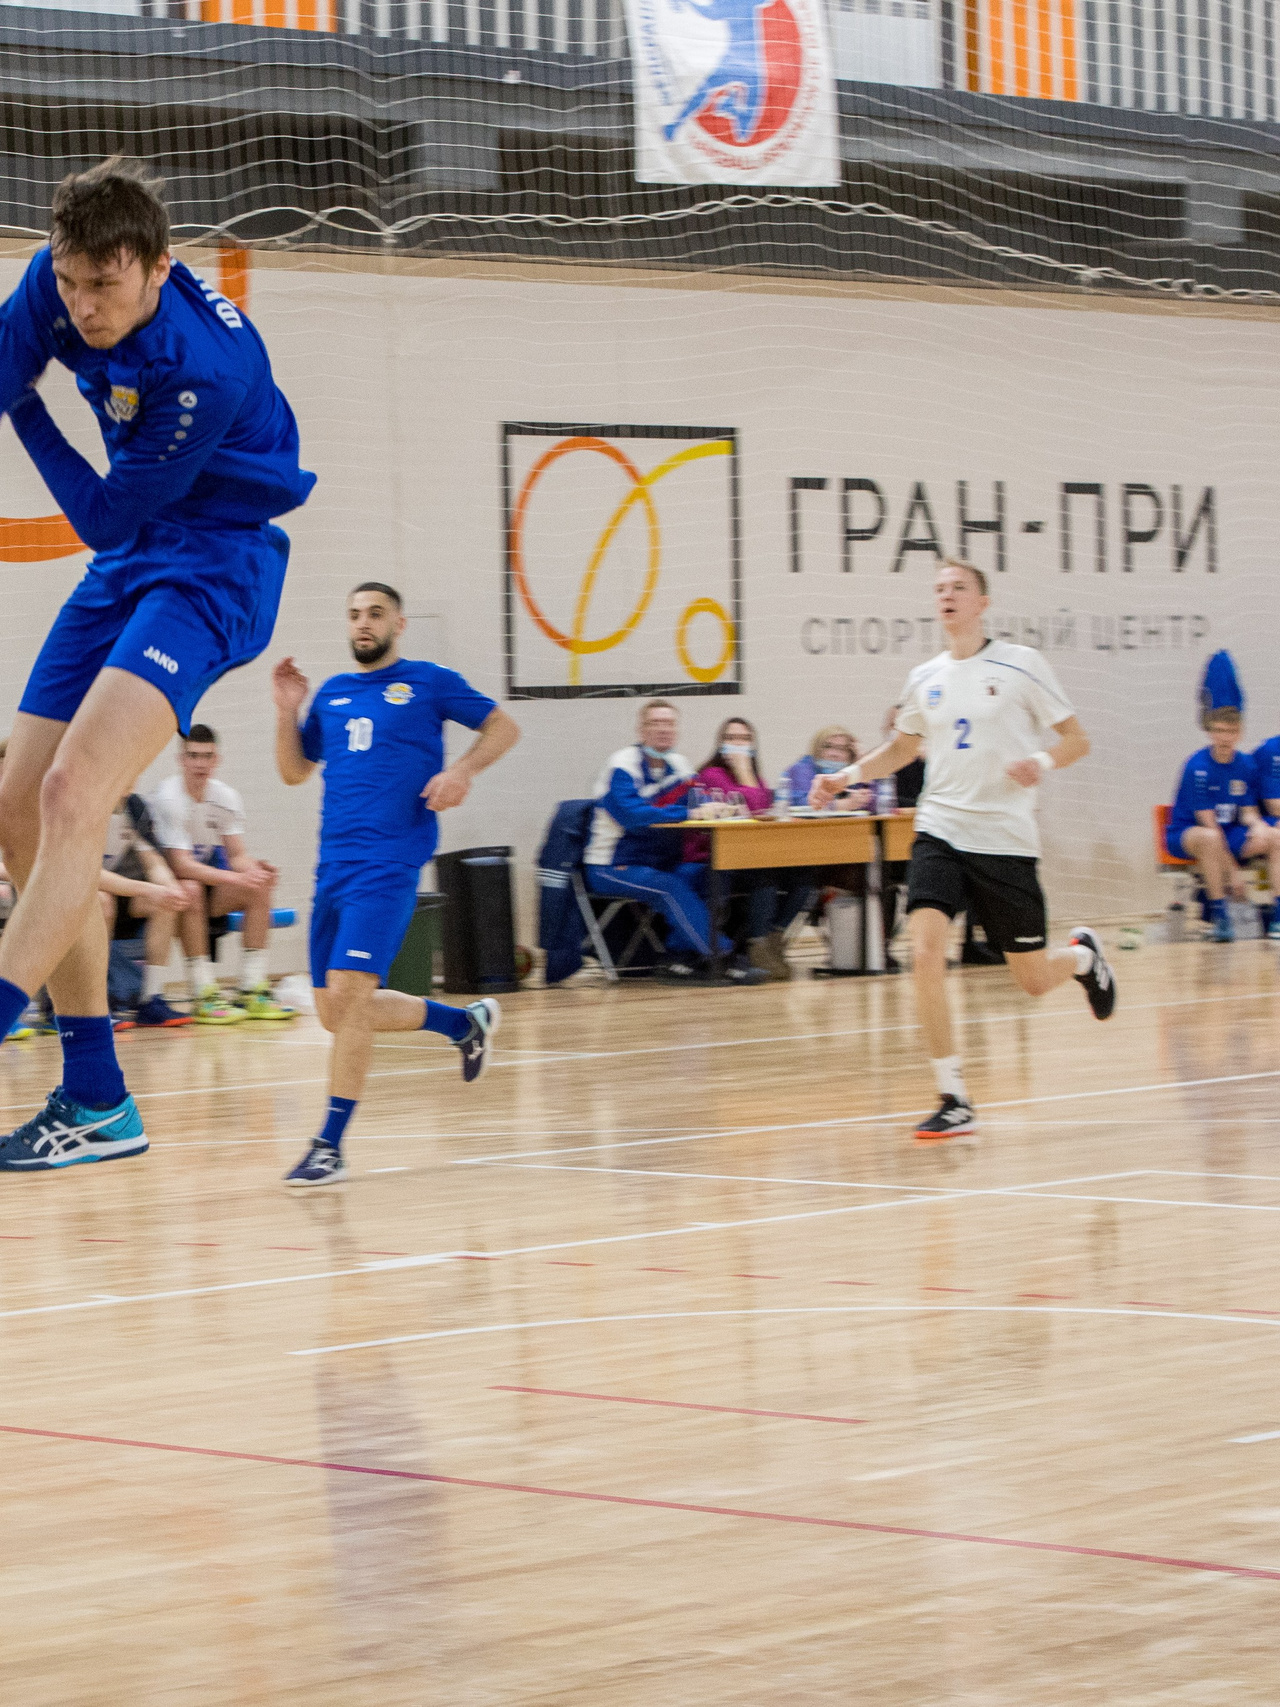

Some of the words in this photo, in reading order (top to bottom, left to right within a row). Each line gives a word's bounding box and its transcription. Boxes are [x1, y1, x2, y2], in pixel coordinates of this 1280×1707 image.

[788, 476, 1219, 574] ГРАН-ПРИ
[801, 608, 1079, 655] СПОРТНЫЙ
[1092, 613, 1210, 653] ЦЕНТР
[143, 645, 179, 675] JAKO
[344, 717, 374, 752] 10
[953, 718, 972, 749] 2
